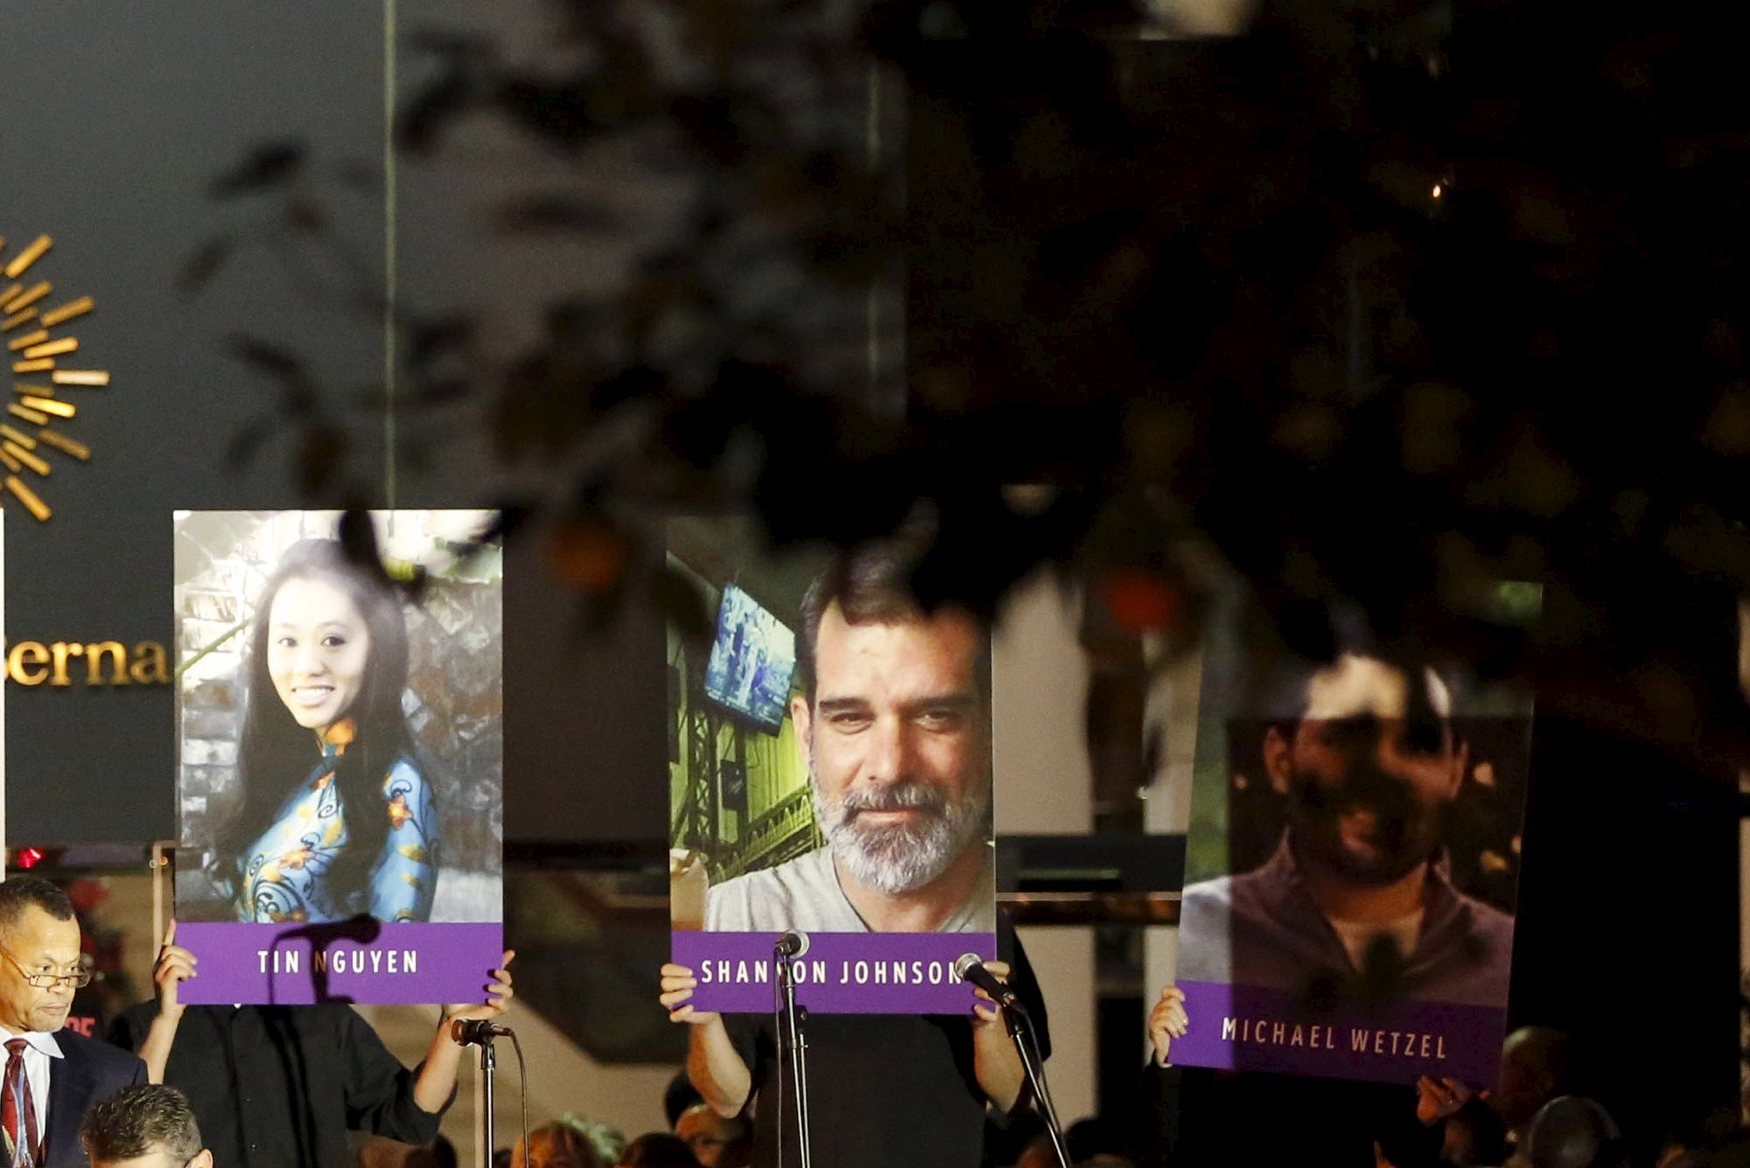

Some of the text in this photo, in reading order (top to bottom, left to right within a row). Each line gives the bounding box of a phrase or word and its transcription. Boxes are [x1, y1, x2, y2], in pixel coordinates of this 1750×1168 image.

[5, 639, 172, 687] erna
[257, 950, 417, 973] TIN NGUYEN
[1221, 1016, 1447, 1060] MICHAEL WETZEL
